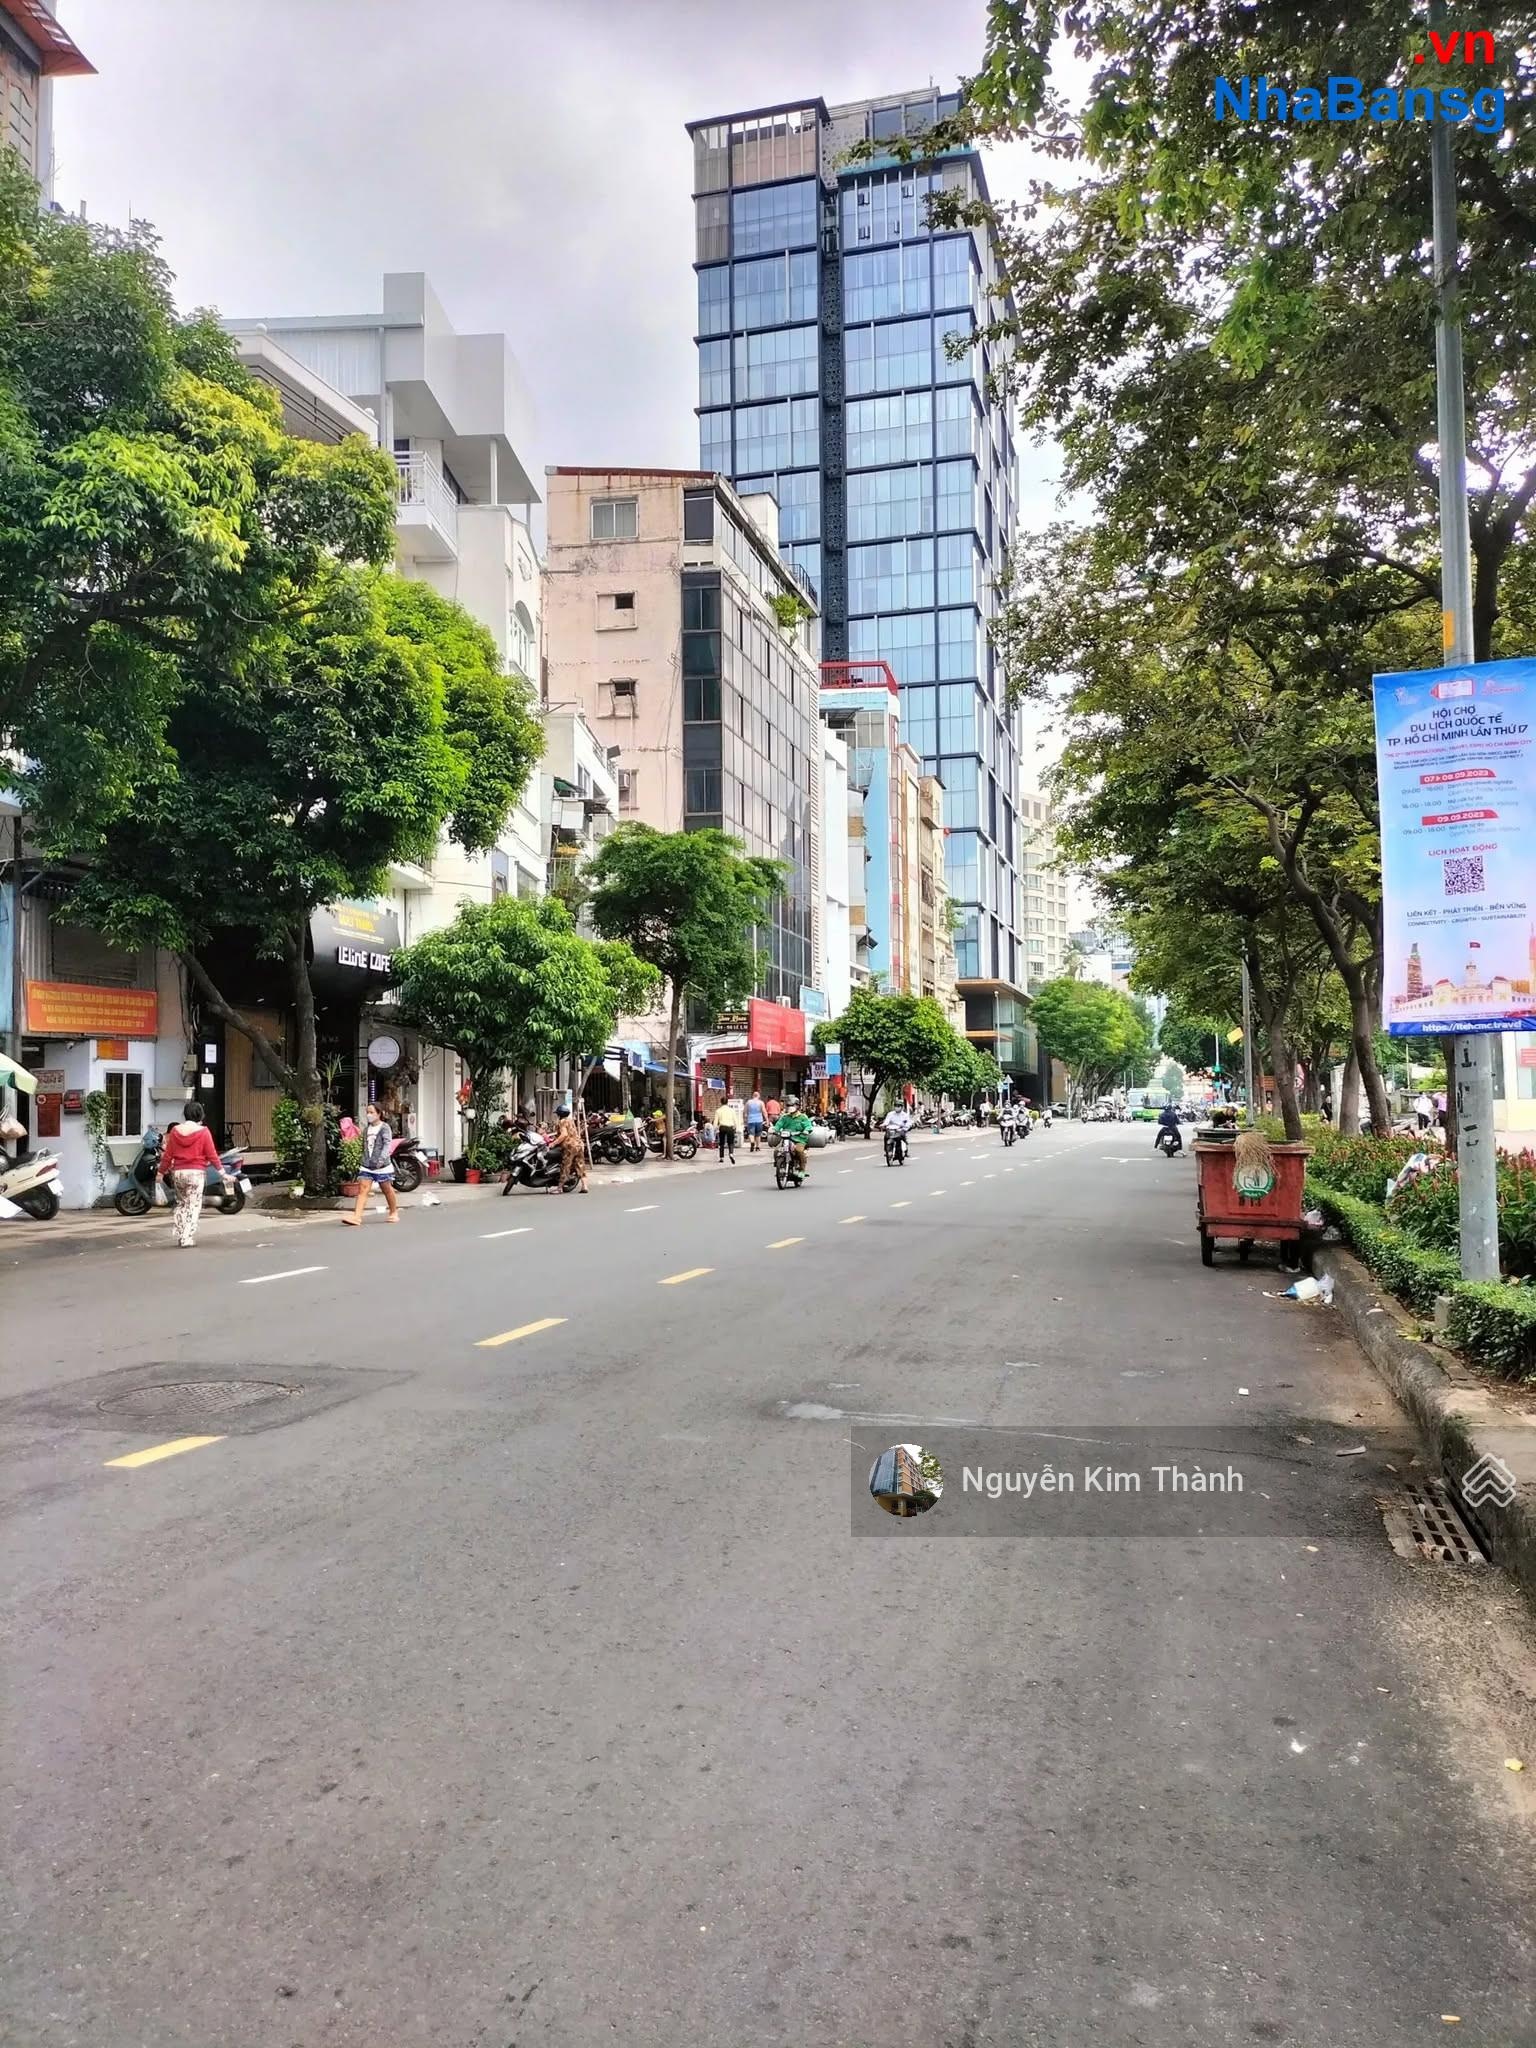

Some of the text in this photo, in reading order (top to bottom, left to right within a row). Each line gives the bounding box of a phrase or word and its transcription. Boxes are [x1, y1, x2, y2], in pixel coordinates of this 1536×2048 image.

[1432, 704, 1476, 719] HỘI CHỢ
[1410, 711, 1503, 733] DU LỊCH QUỐC TẾ
[1441, 728, 1468, 741] MINH
[369, 952, 391, 973] CAFE
